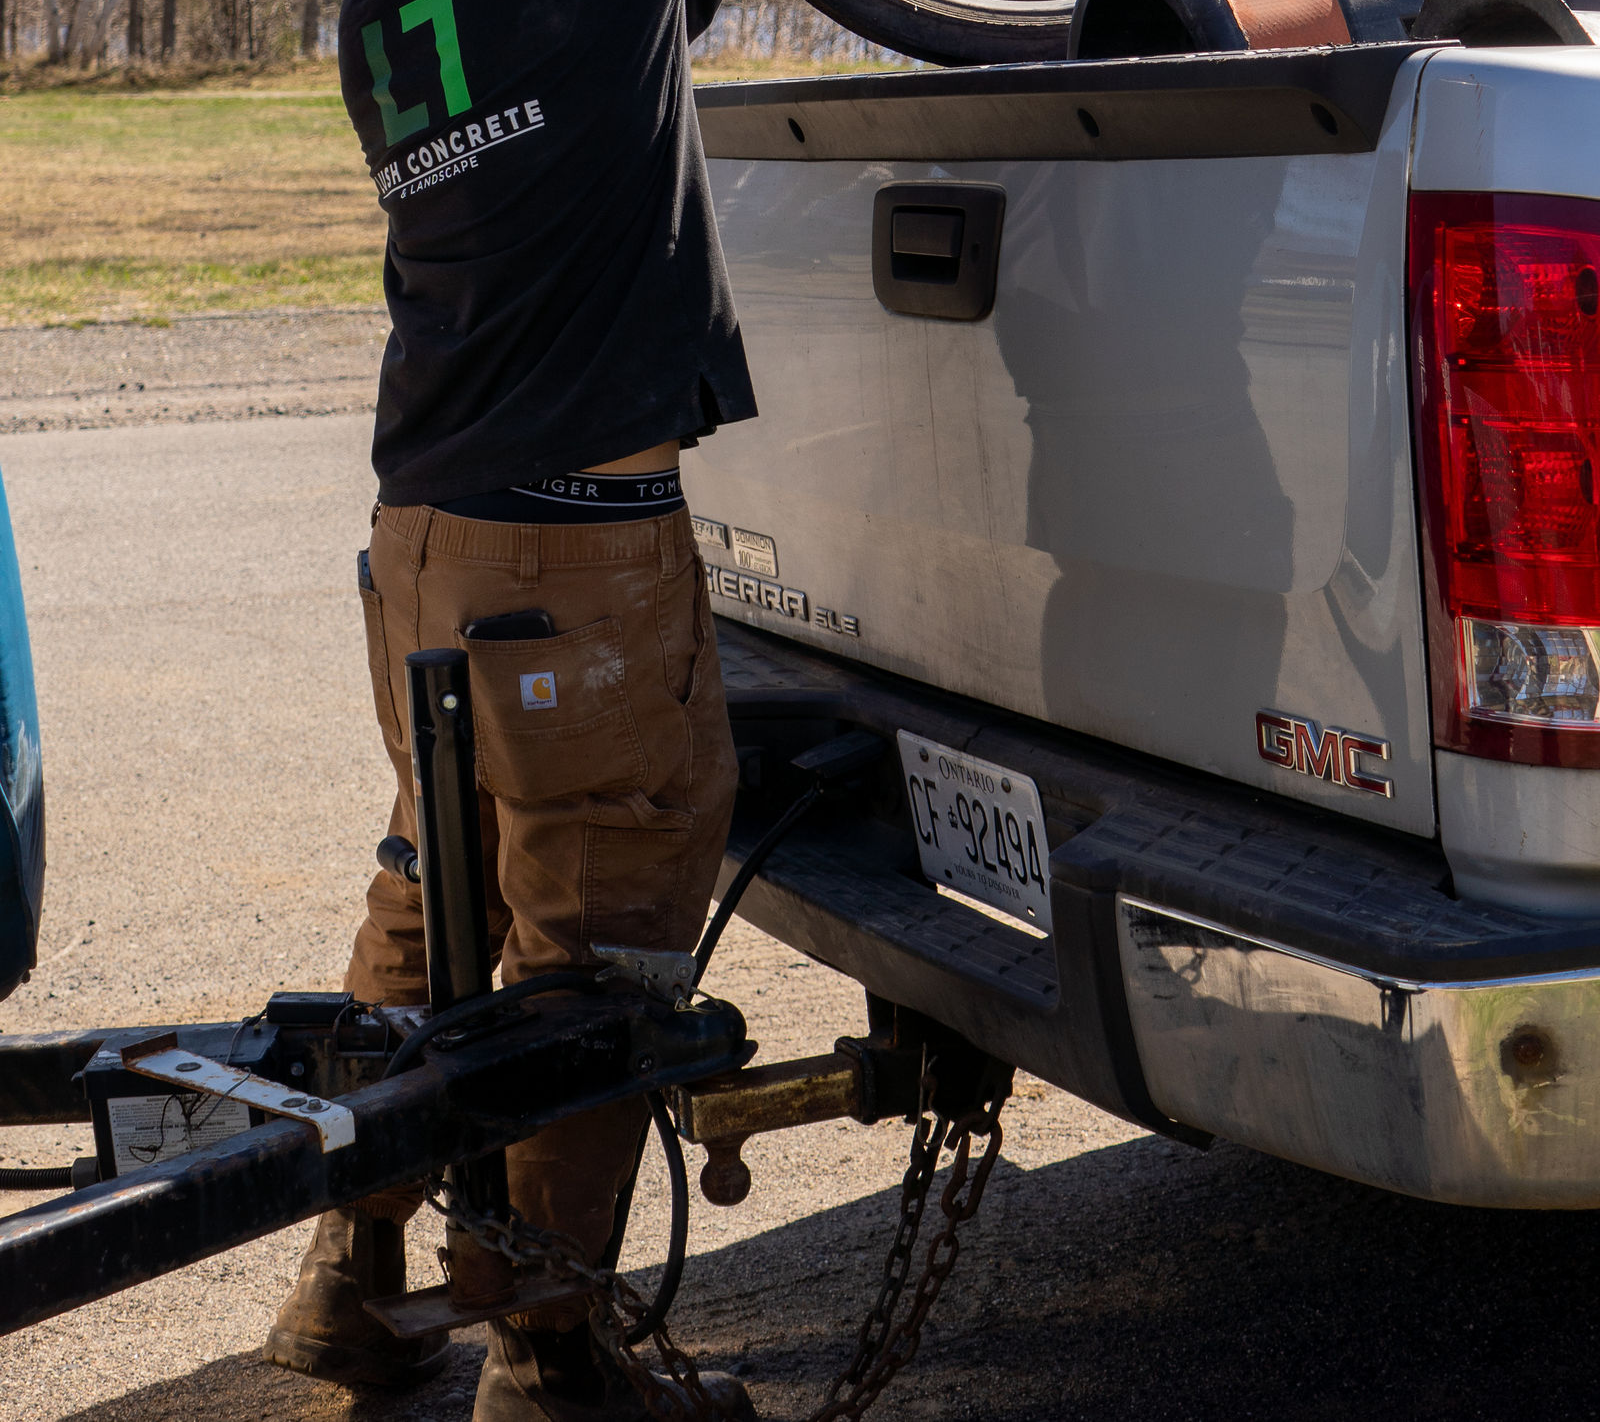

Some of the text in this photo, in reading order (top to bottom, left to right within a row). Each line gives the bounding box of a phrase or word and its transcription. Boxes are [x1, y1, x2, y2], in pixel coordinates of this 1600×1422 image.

[407, 99, 545, 175] CONCRETE
[400, 155, 479, 199] & LANDSCAPE
[529, 479, 682, 498] IGER TOM
[735, 530, 771, 551] DOMINION
[814, 606, 860, 638] SLE
[1255, 708, 1395, 799] GMC
[938, 755, 995, 794] ONTARIO
[909, 774, 1046, 896] CF 92494
